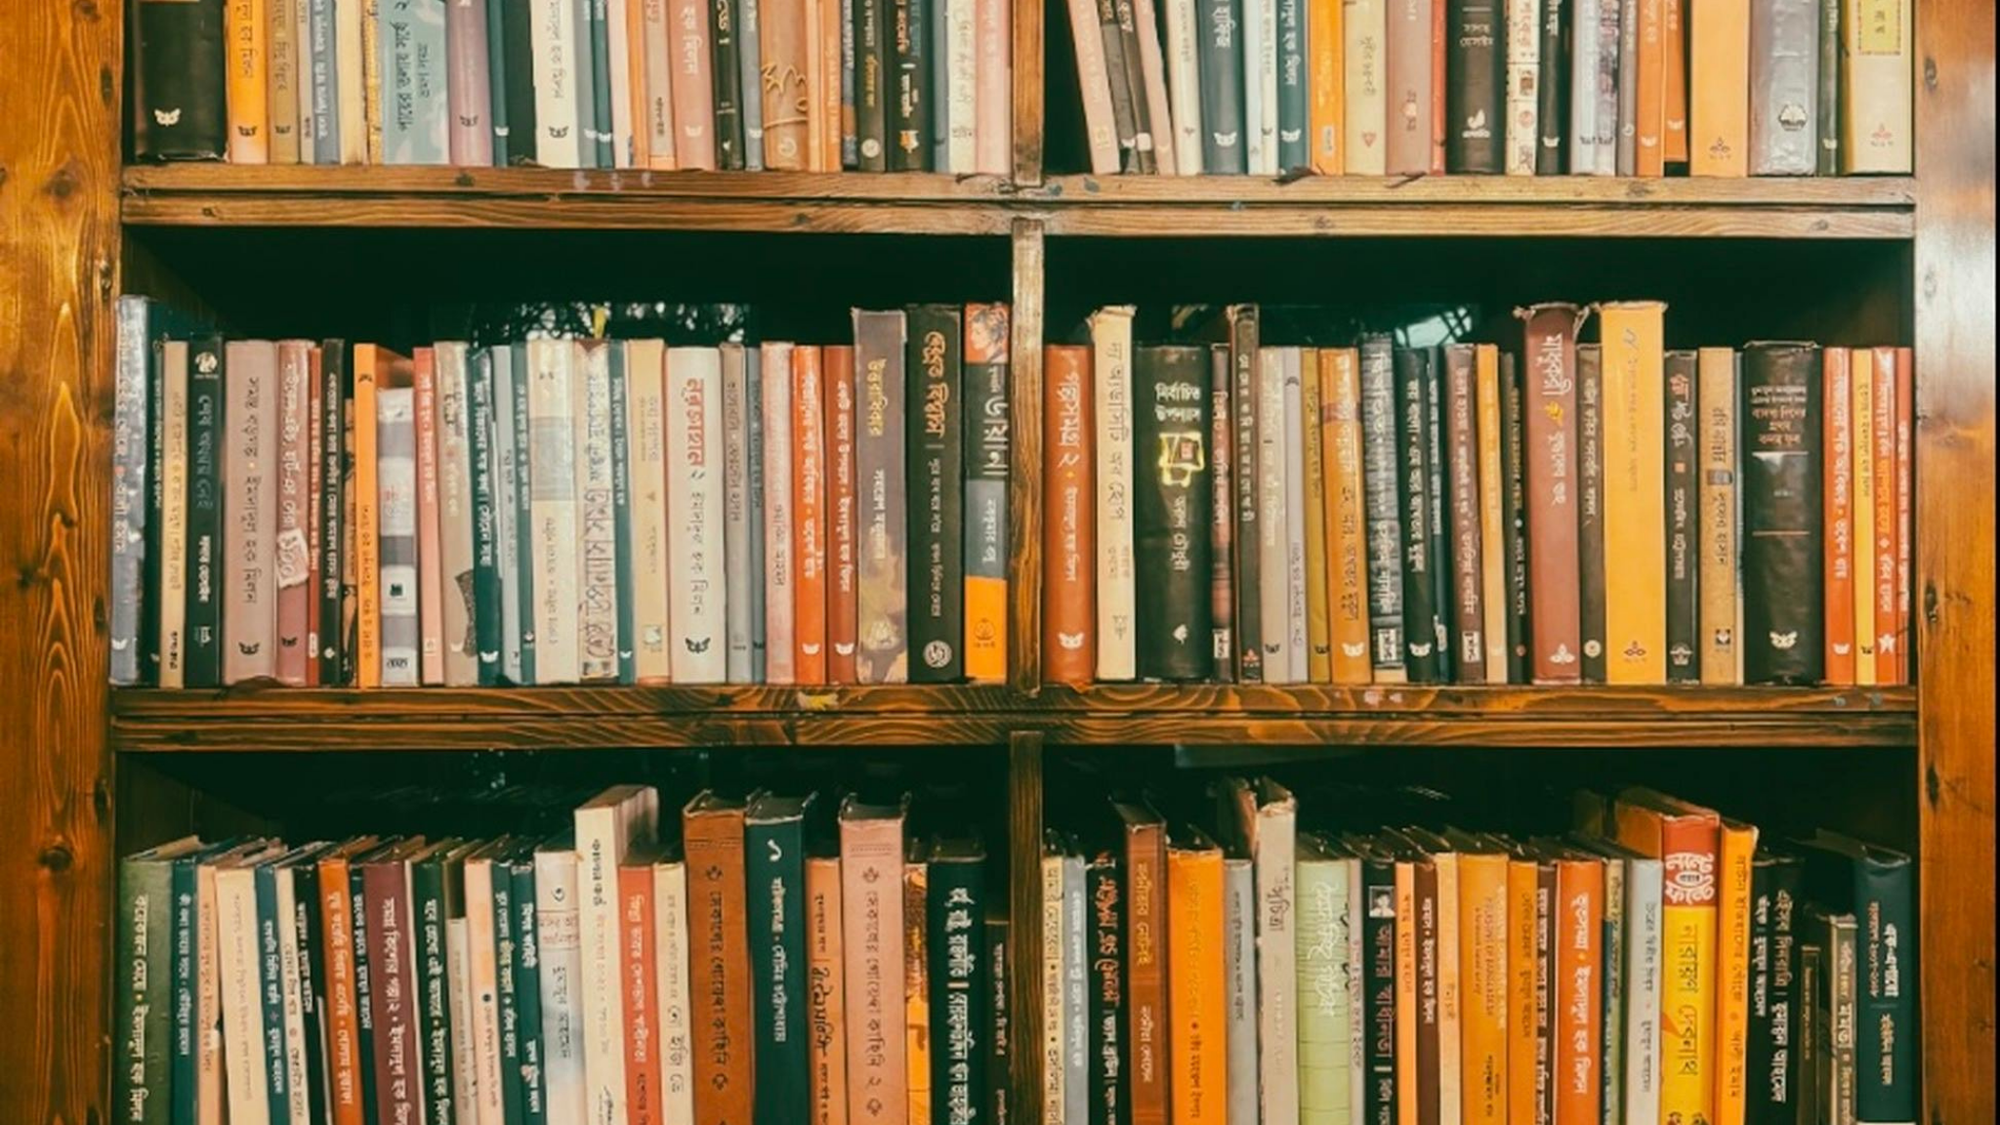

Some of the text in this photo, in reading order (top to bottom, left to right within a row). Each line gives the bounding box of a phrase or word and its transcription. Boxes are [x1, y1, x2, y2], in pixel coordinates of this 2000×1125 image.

[1535, 333, 1572, 397] মাধুকরী
[681, 378, 705, 467] নূরজাহান
[1109, 481, 1128, 521] হোপ
[1549, 481, 1566, 506] গুহ
[1065, 534, 1079, 552] হক
[244, 567, 262, 604] মিলন
[840, 564, 852, 592] মিলন
[1066, 554, 1080, 582] মিলন
[1267, 886, 1288, 931] সুচিত্রা
[1775, 889, 1791, 931] এইসব
[711, 891, 728, 1065] সেকালের গোয়েন্দা কাহিনি
[948, 935, 974, 978] রাজনীতি
[1752, 936, 1766, 1017] হুমায়ূন আহমেদ
[1883, 923, 1899, 997] এক-এগারো
[865, 891, 884, 1088] সেকালের গোয়েন্দা কাহিনি ২
[1375, 924, 1394, 1057] আমার স্বাধীনতা
[1424, 998, 1435, 1024] মিলন
[1570, 966, 1589, 1024] ইমদাদুল
[1677, 924, 1700, 1077] নারায়ণ দেবনাথ
[128, 1004, 149, 1057] ইমদাদুল
[1574, 1029, 1590, 1053] হক
[1772, 1002, 1788, 1046] হুমায়ূন
[1837, 1003, 1852, 1048] মমতা
[389, 1025, 404, 1074] ইমদাদুল
[433, 1028, 446, 1074] ইমদাদুল
[670, 1035, 686, 1068] ইজি
[132, 1062, 149, 1085] হক
[391, 1078, 407, 1099] হক
[435, 1077, 448, 1097] হক
[951, 1063, 970, 1081] খান
[1575, 1056, 1590, 1094] মিলন
[1771, 1049, 1787, 1103] আহমেদ
[131, 1088, 149, 1122] মিলন
